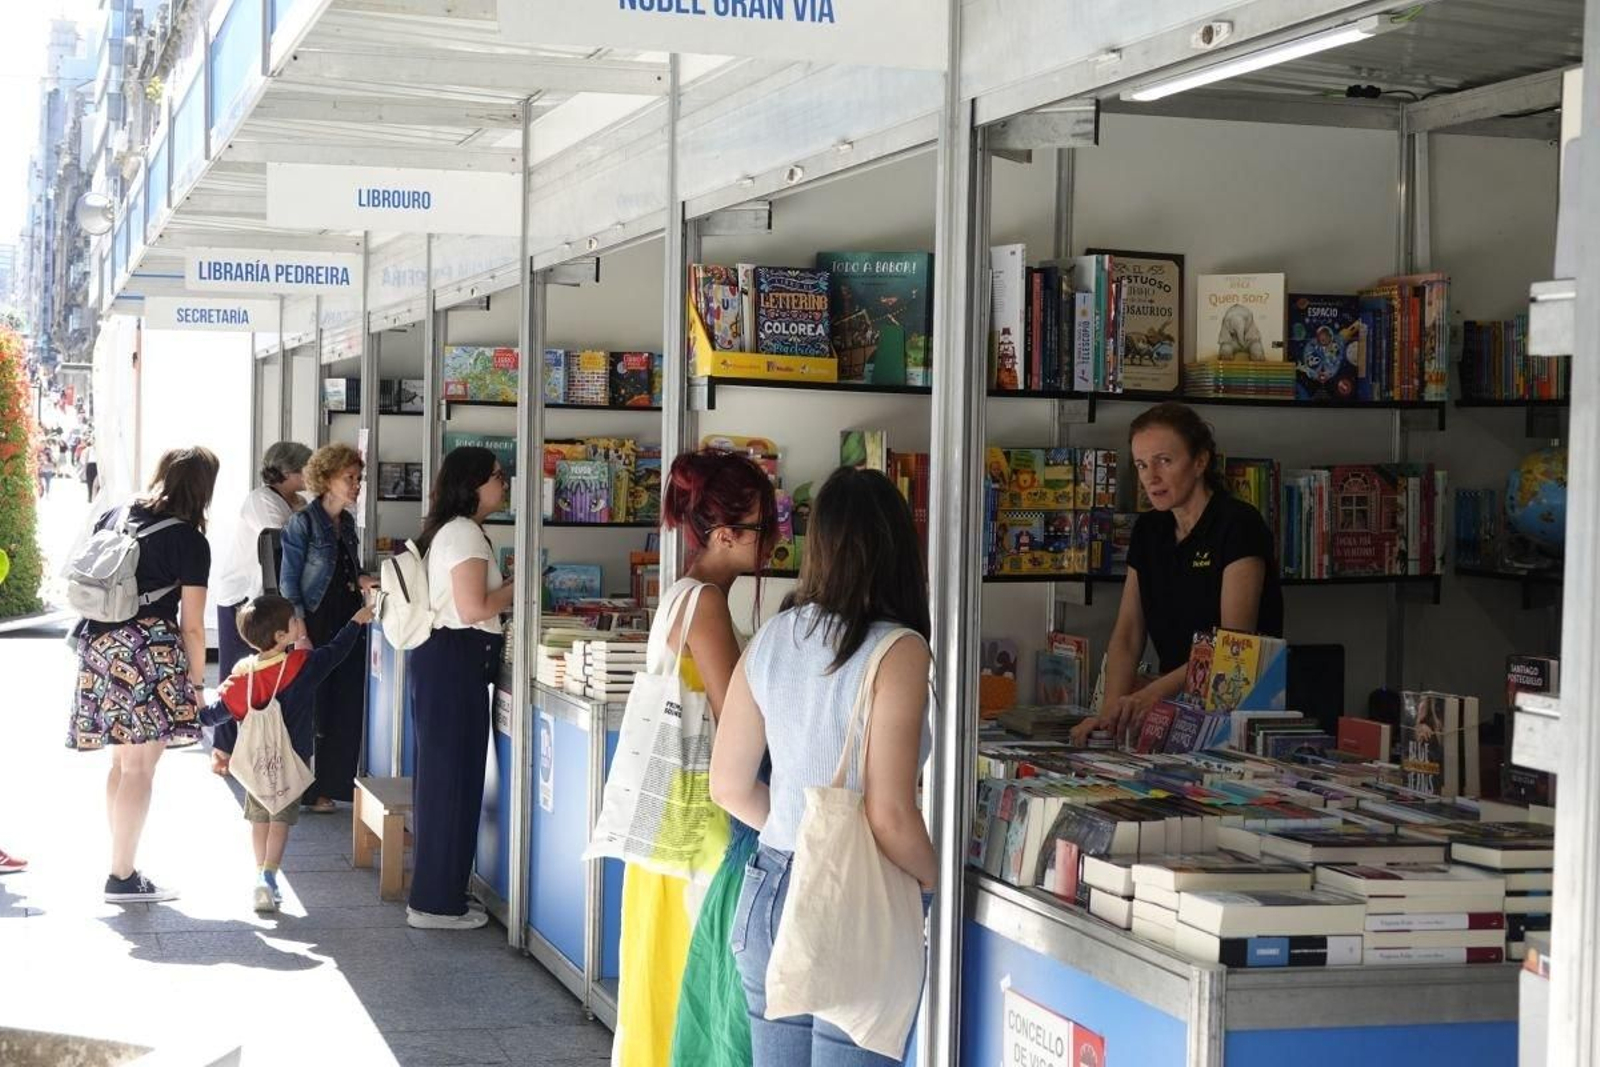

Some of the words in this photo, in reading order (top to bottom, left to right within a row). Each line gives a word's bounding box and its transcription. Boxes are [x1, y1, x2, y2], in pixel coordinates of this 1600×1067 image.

[358, 188, 431, 209] LIBROURO
[199, 260, 270, 282] LIBRARÍA
[275, 264, 350, 285] PEDREIRA
[177, 307, 250, 324] SECRETARÍA
[764, 321, 826, 337] COLOREA
[1008, 1010, 1065, 1058] CONCELLO
[1014, 1043, 1028, 1067] DE
